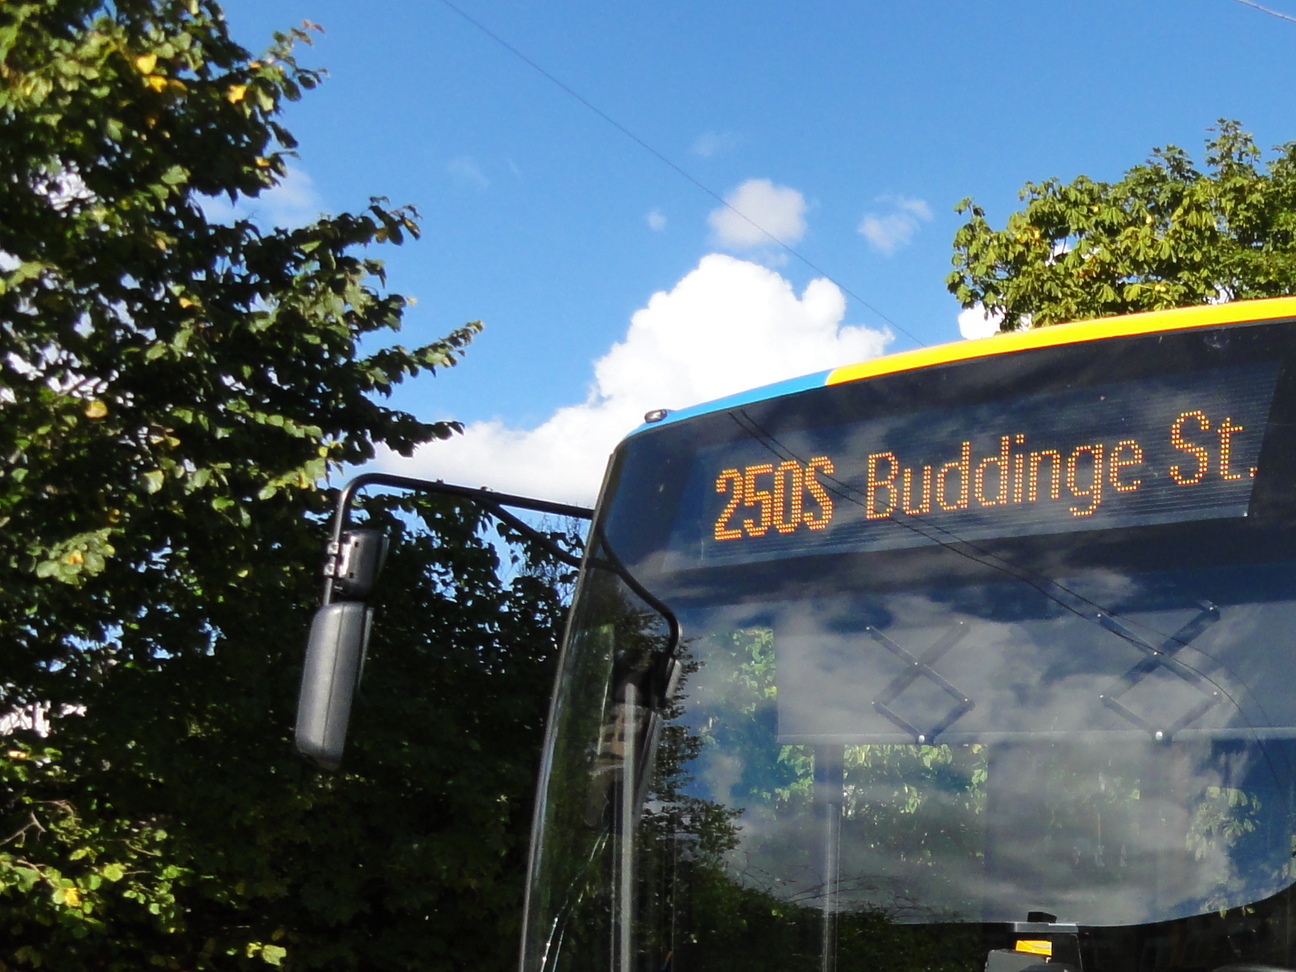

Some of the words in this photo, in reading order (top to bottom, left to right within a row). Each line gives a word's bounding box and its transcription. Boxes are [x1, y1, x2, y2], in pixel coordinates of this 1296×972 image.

[714, 456, 834, 541] 250S
[866, 434, 1143, 518] Buddinge
[1169, 410, 1259, 486] St.
